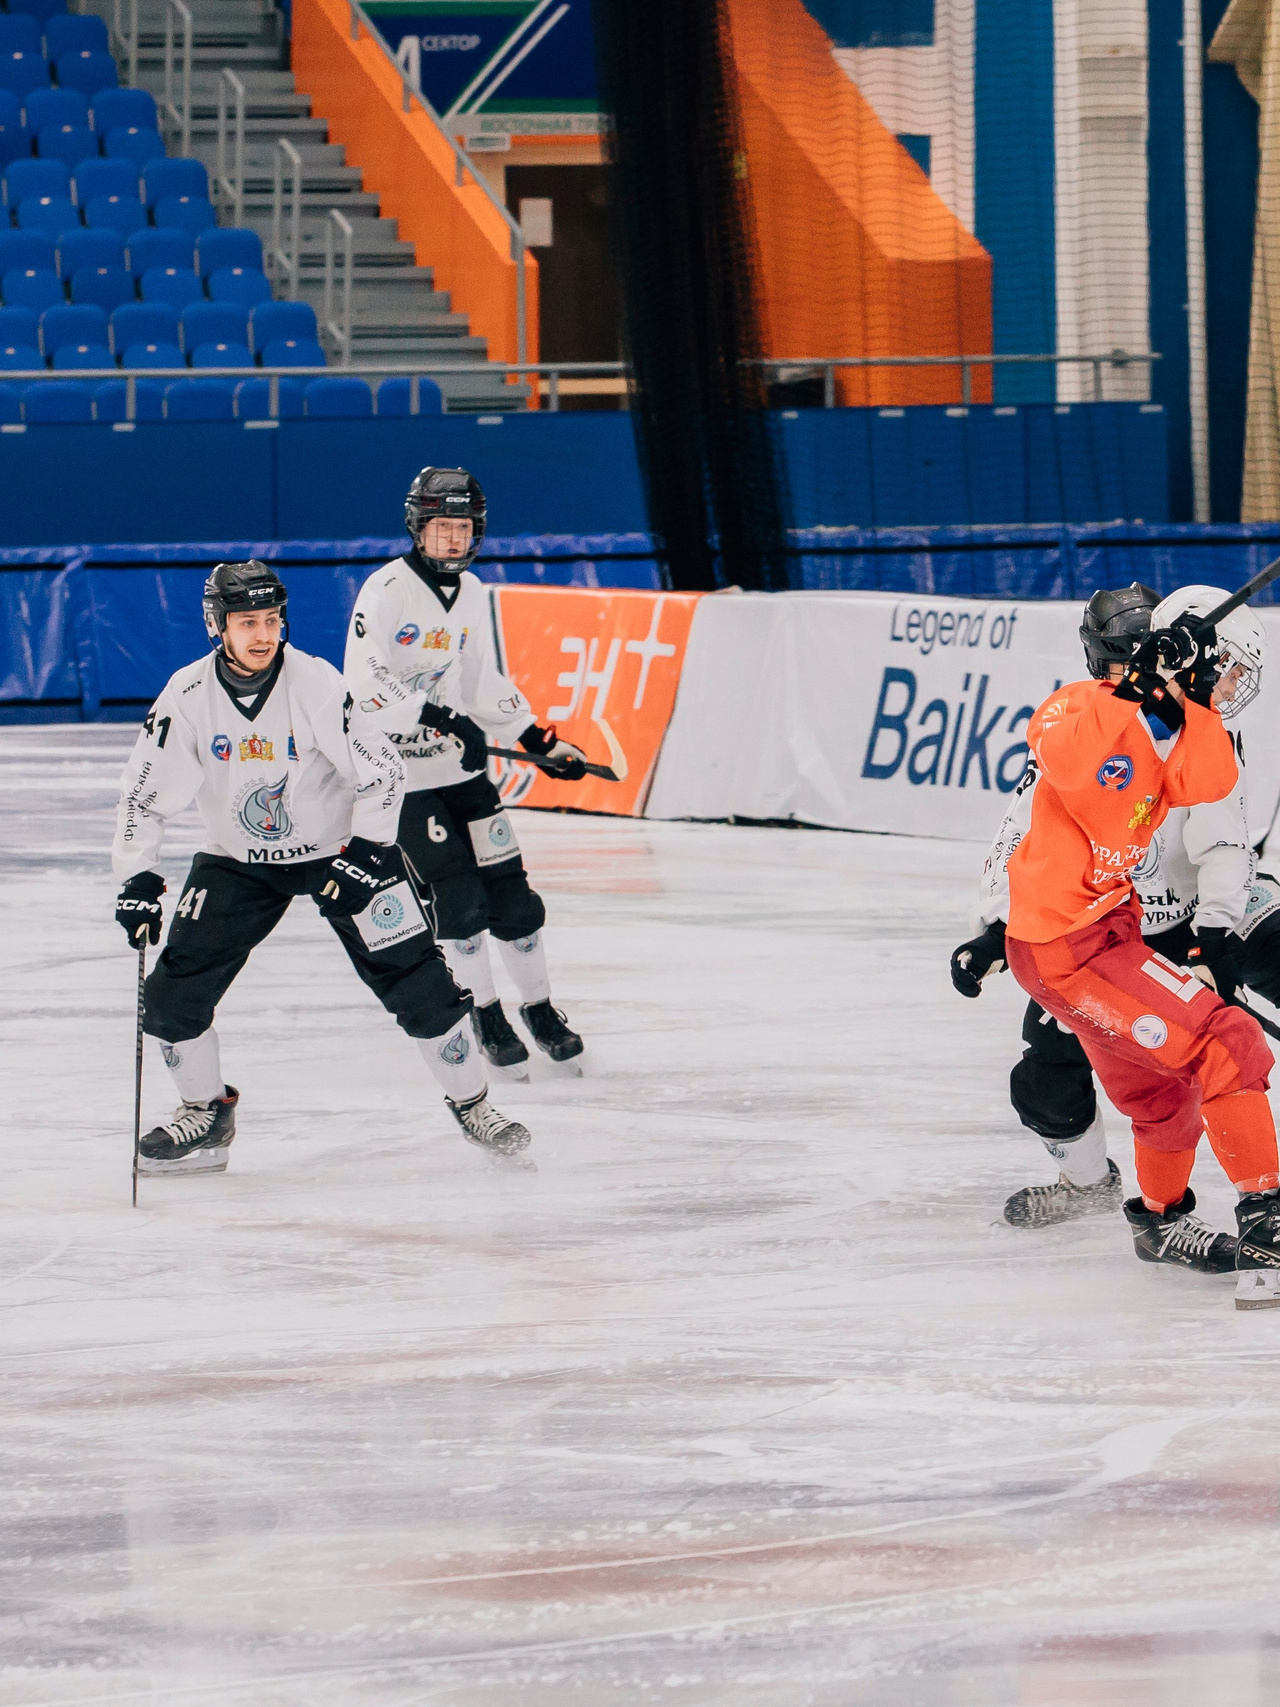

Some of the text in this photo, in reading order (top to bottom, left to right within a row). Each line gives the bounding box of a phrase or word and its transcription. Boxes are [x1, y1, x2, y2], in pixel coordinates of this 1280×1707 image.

[248, 587, 274, 597] CCM
[355, 612, 366, 638] 6
[889, 605, 1018, 656] Legend of
[143, 708, 172, 749] 41
[861, 667, 1061, 793] Baika
[427, 815, 448, 843] 6
[247, 844, 321, 863] Маяк
[331, 858, 380, 888] CCM
[116, 899, 160, 914] CCM
[176, 887, 208, 920] 41
